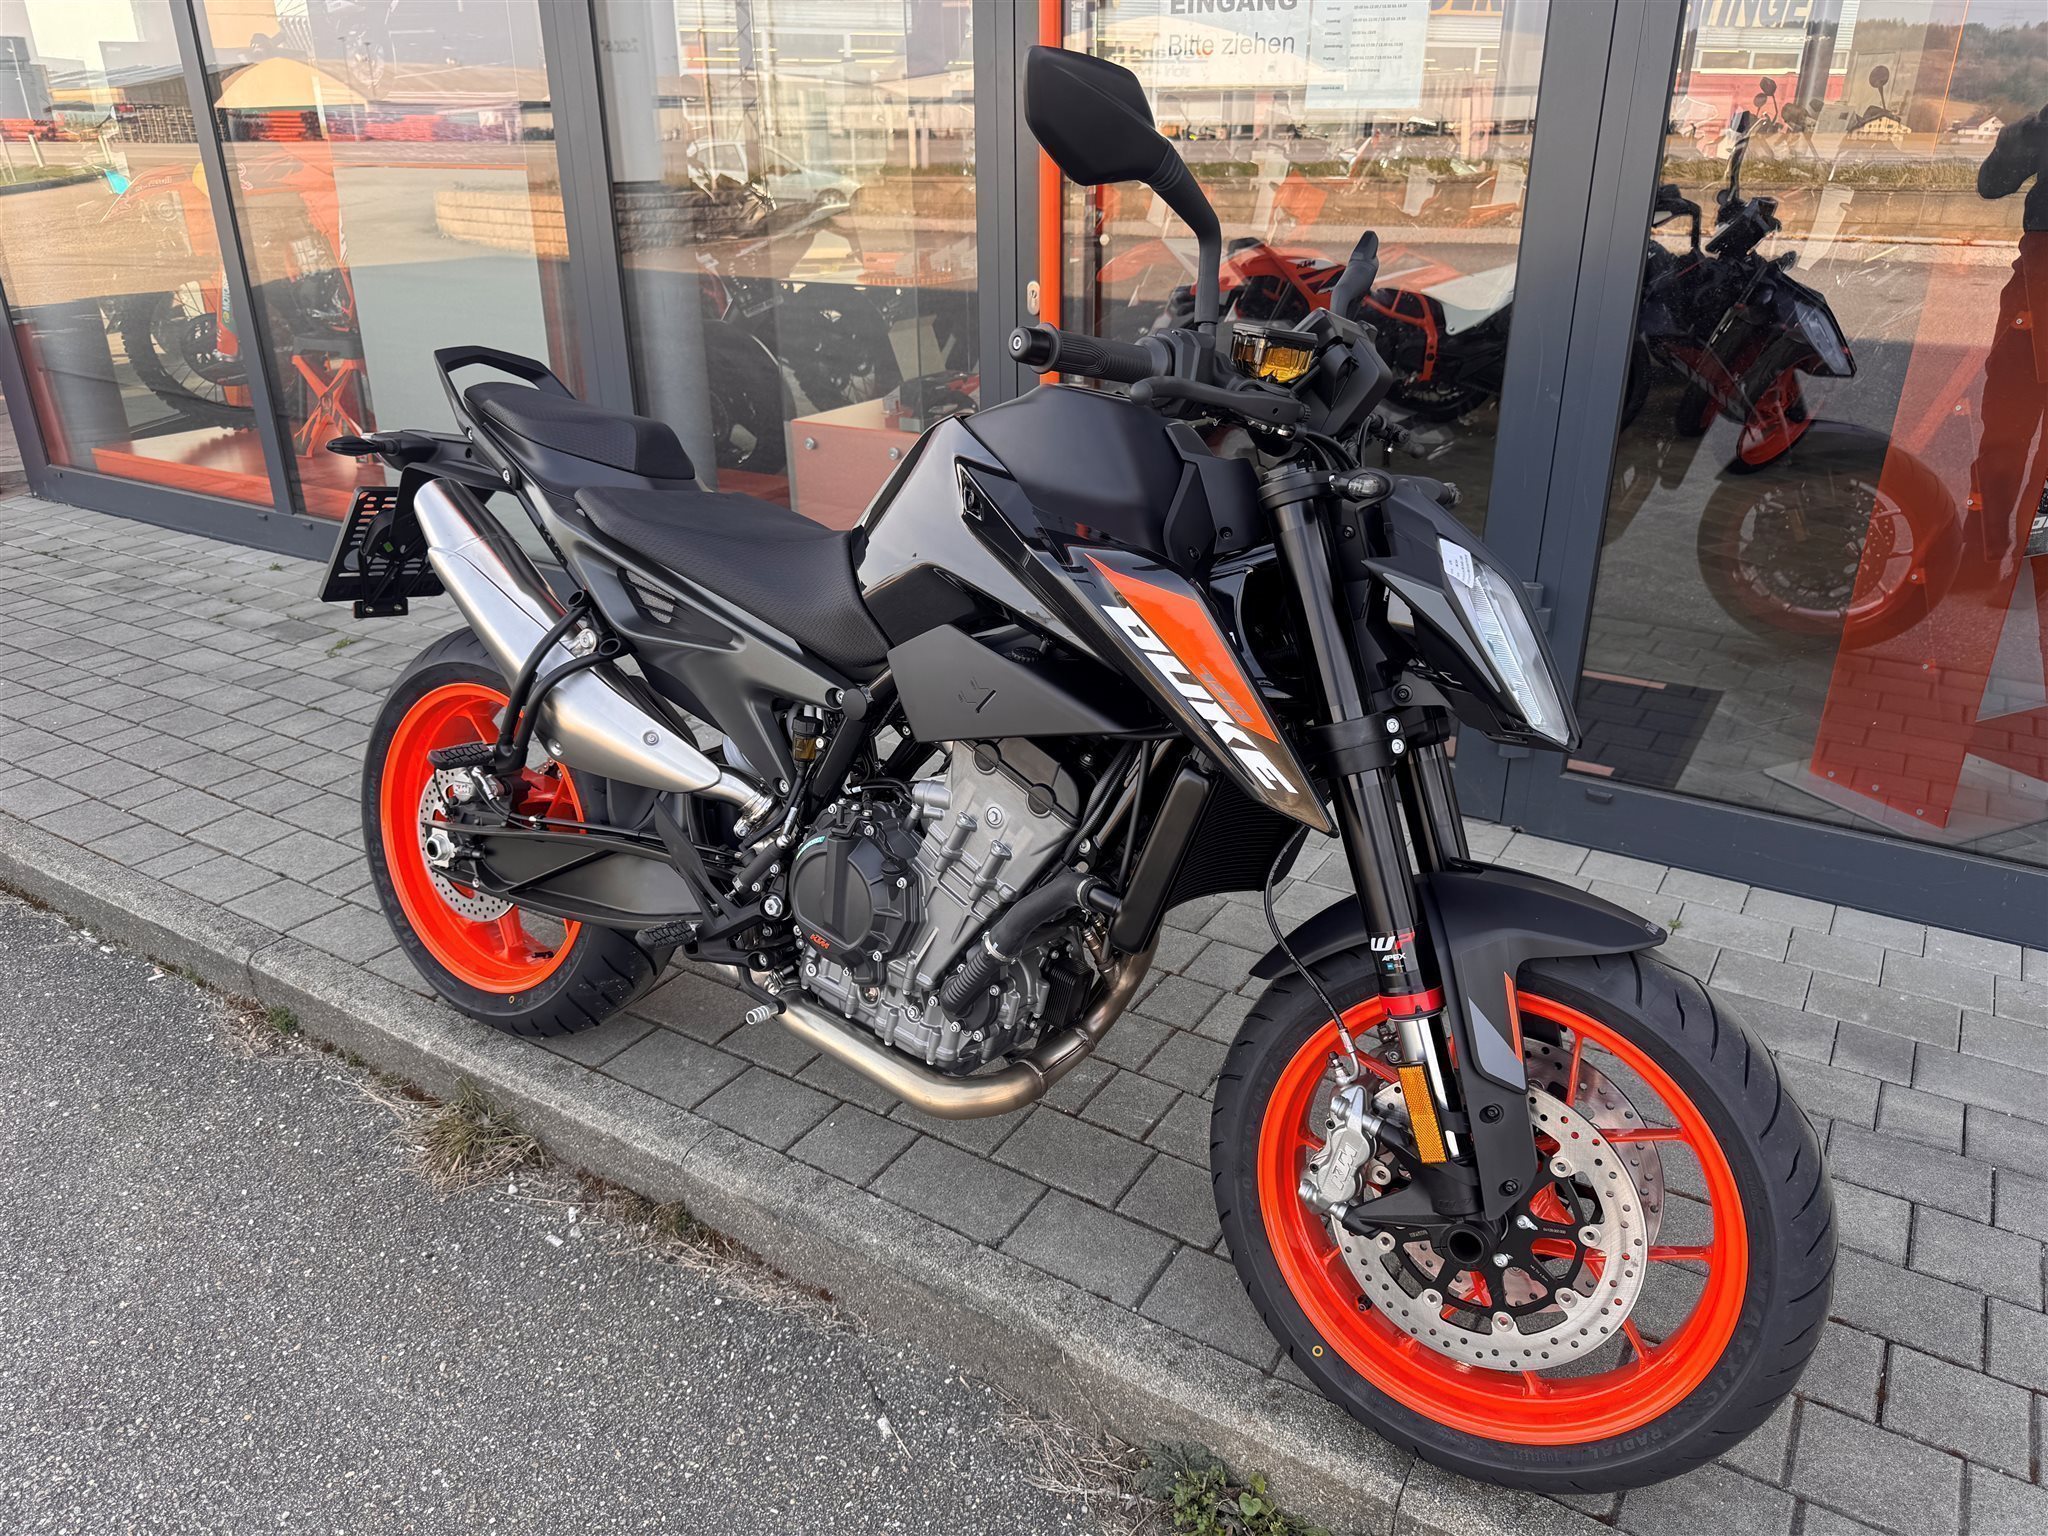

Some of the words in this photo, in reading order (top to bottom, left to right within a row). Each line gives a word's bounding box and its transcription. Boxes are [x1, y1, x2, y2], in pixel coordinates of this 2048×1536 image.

[1168, 34, 1215, 56] Bitte
[1221, 32, 1296, 55] ziehen
[1101, 604, 1299, 794] DUKE
[809, 933, 831, 949] KTM
[1381, 952, 1407, 962] APEX
[1330, 1142, 1358, 1190] KTM
